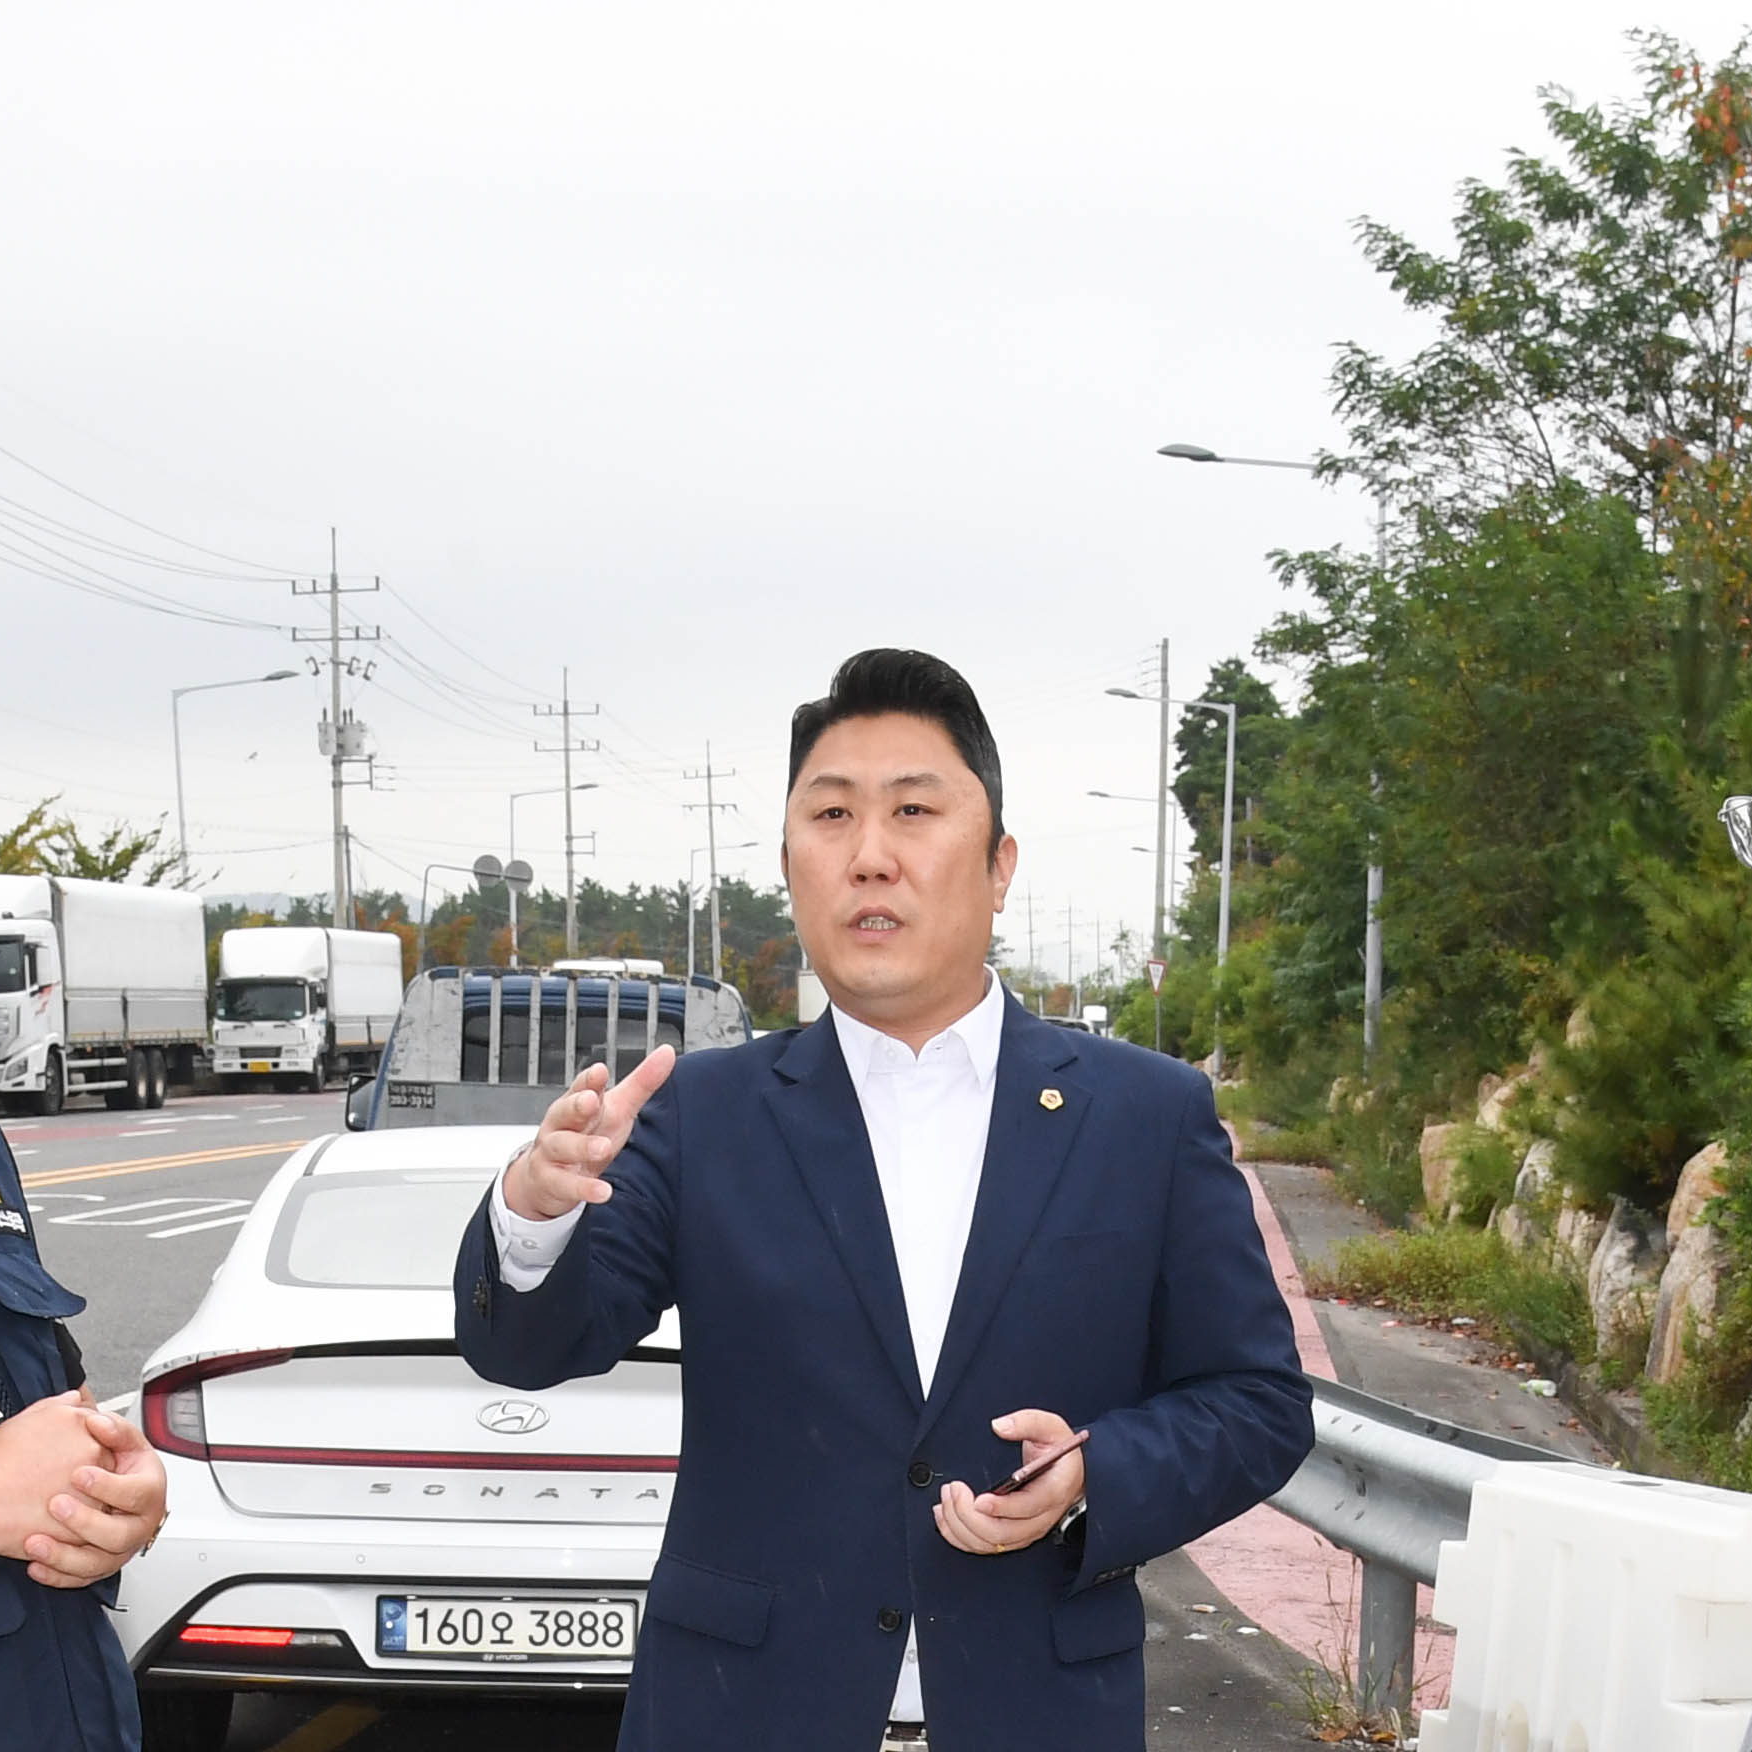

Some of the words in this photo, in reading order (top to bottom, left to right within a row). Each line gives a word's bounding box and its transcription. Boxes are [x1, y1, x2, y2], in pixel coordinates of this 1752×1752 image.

[368, 1483, 660, 1501] SONATA
[414, 1608, 514, 1647] 160오
[527, 1609, 625, 1649] 3888
